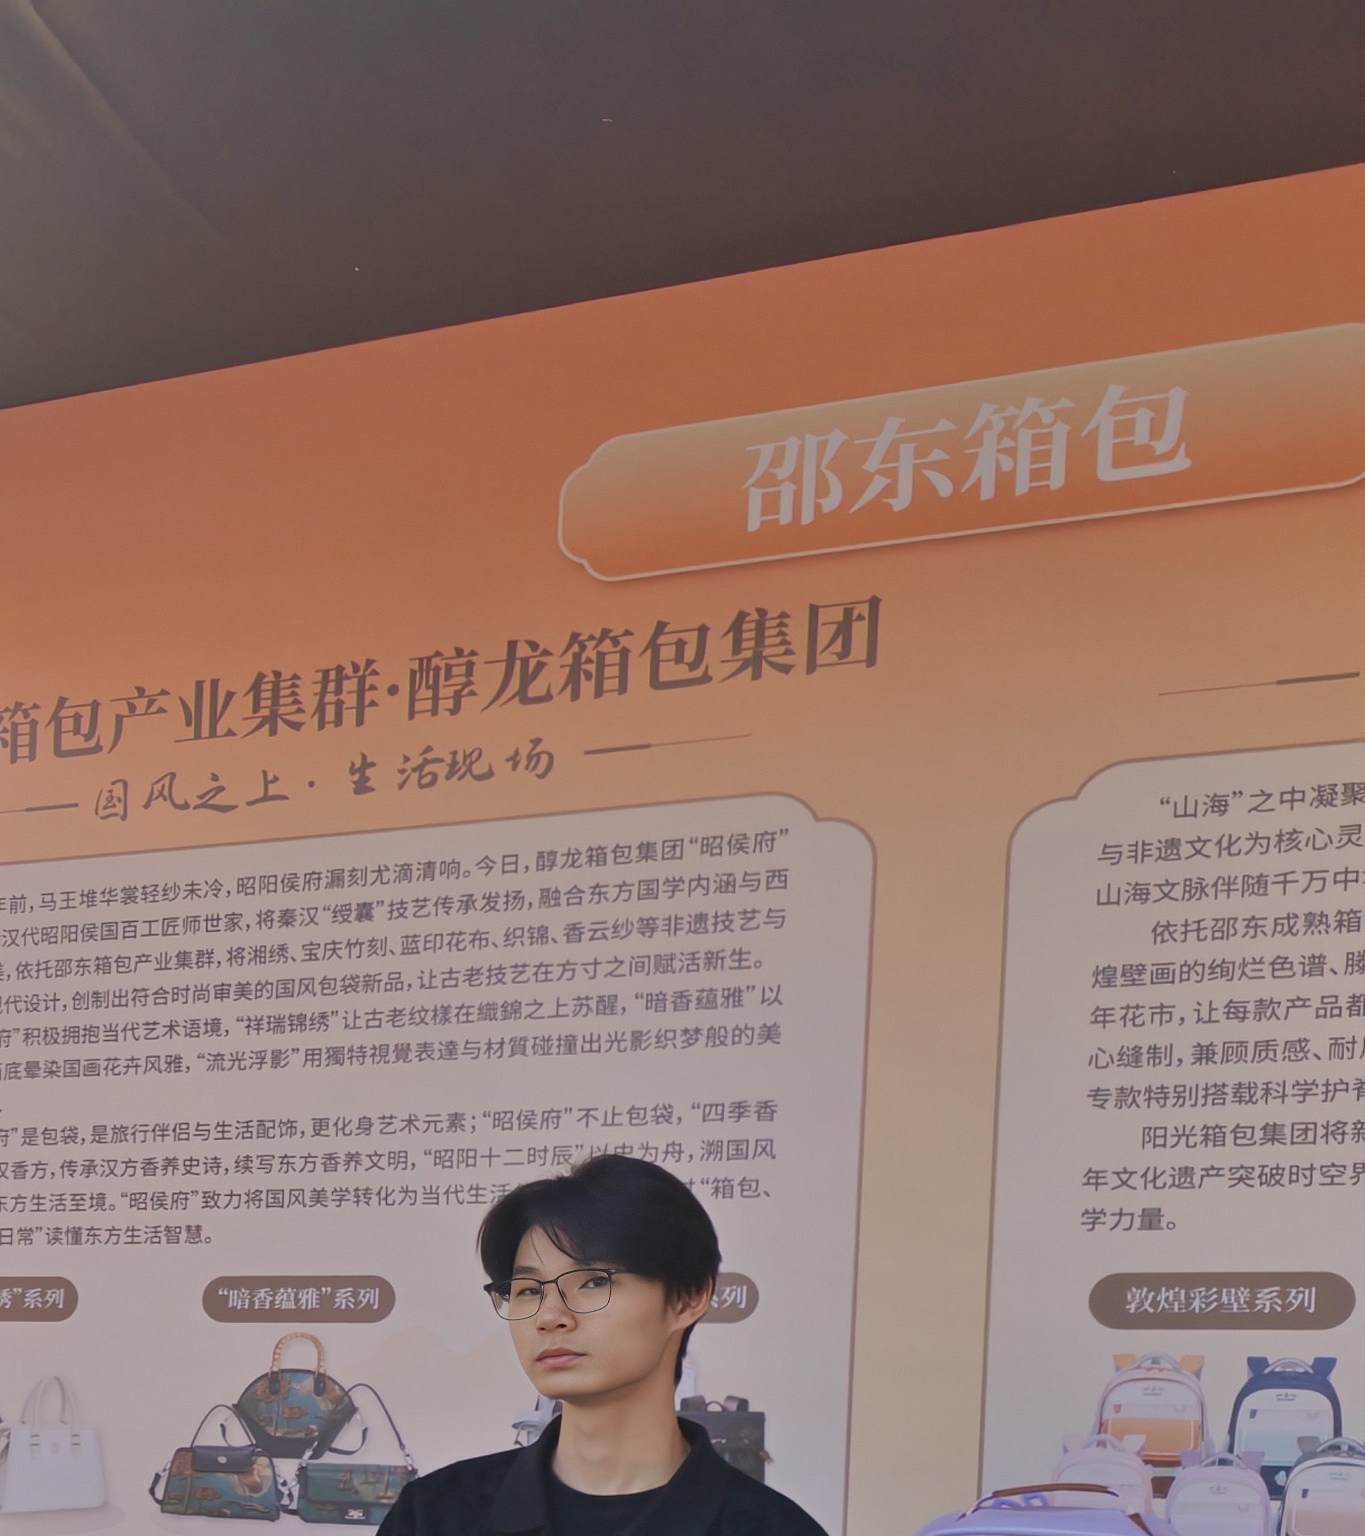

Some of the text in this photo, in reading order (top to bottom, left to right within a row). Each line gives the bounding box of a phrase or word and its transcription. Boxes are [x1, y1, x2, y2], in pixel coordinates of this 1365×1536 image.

[741, 382, 1191, 535] 邵东箱包
[1097, 824, 1364, 866] 与非遗文化为核心灵
[1096, 867, 1365, 907] 山海文脉伴随千万中
[1151, 909, 1362, 946] 依托邵东成熟箱
[1088, 1036, 1365, 1070] 心缝制，兼顾质感、耐
[1080, 1207, 1177, 1232] 学力量。
[1125, 1285, 1317, 1316] 敦煌彩壁系列
